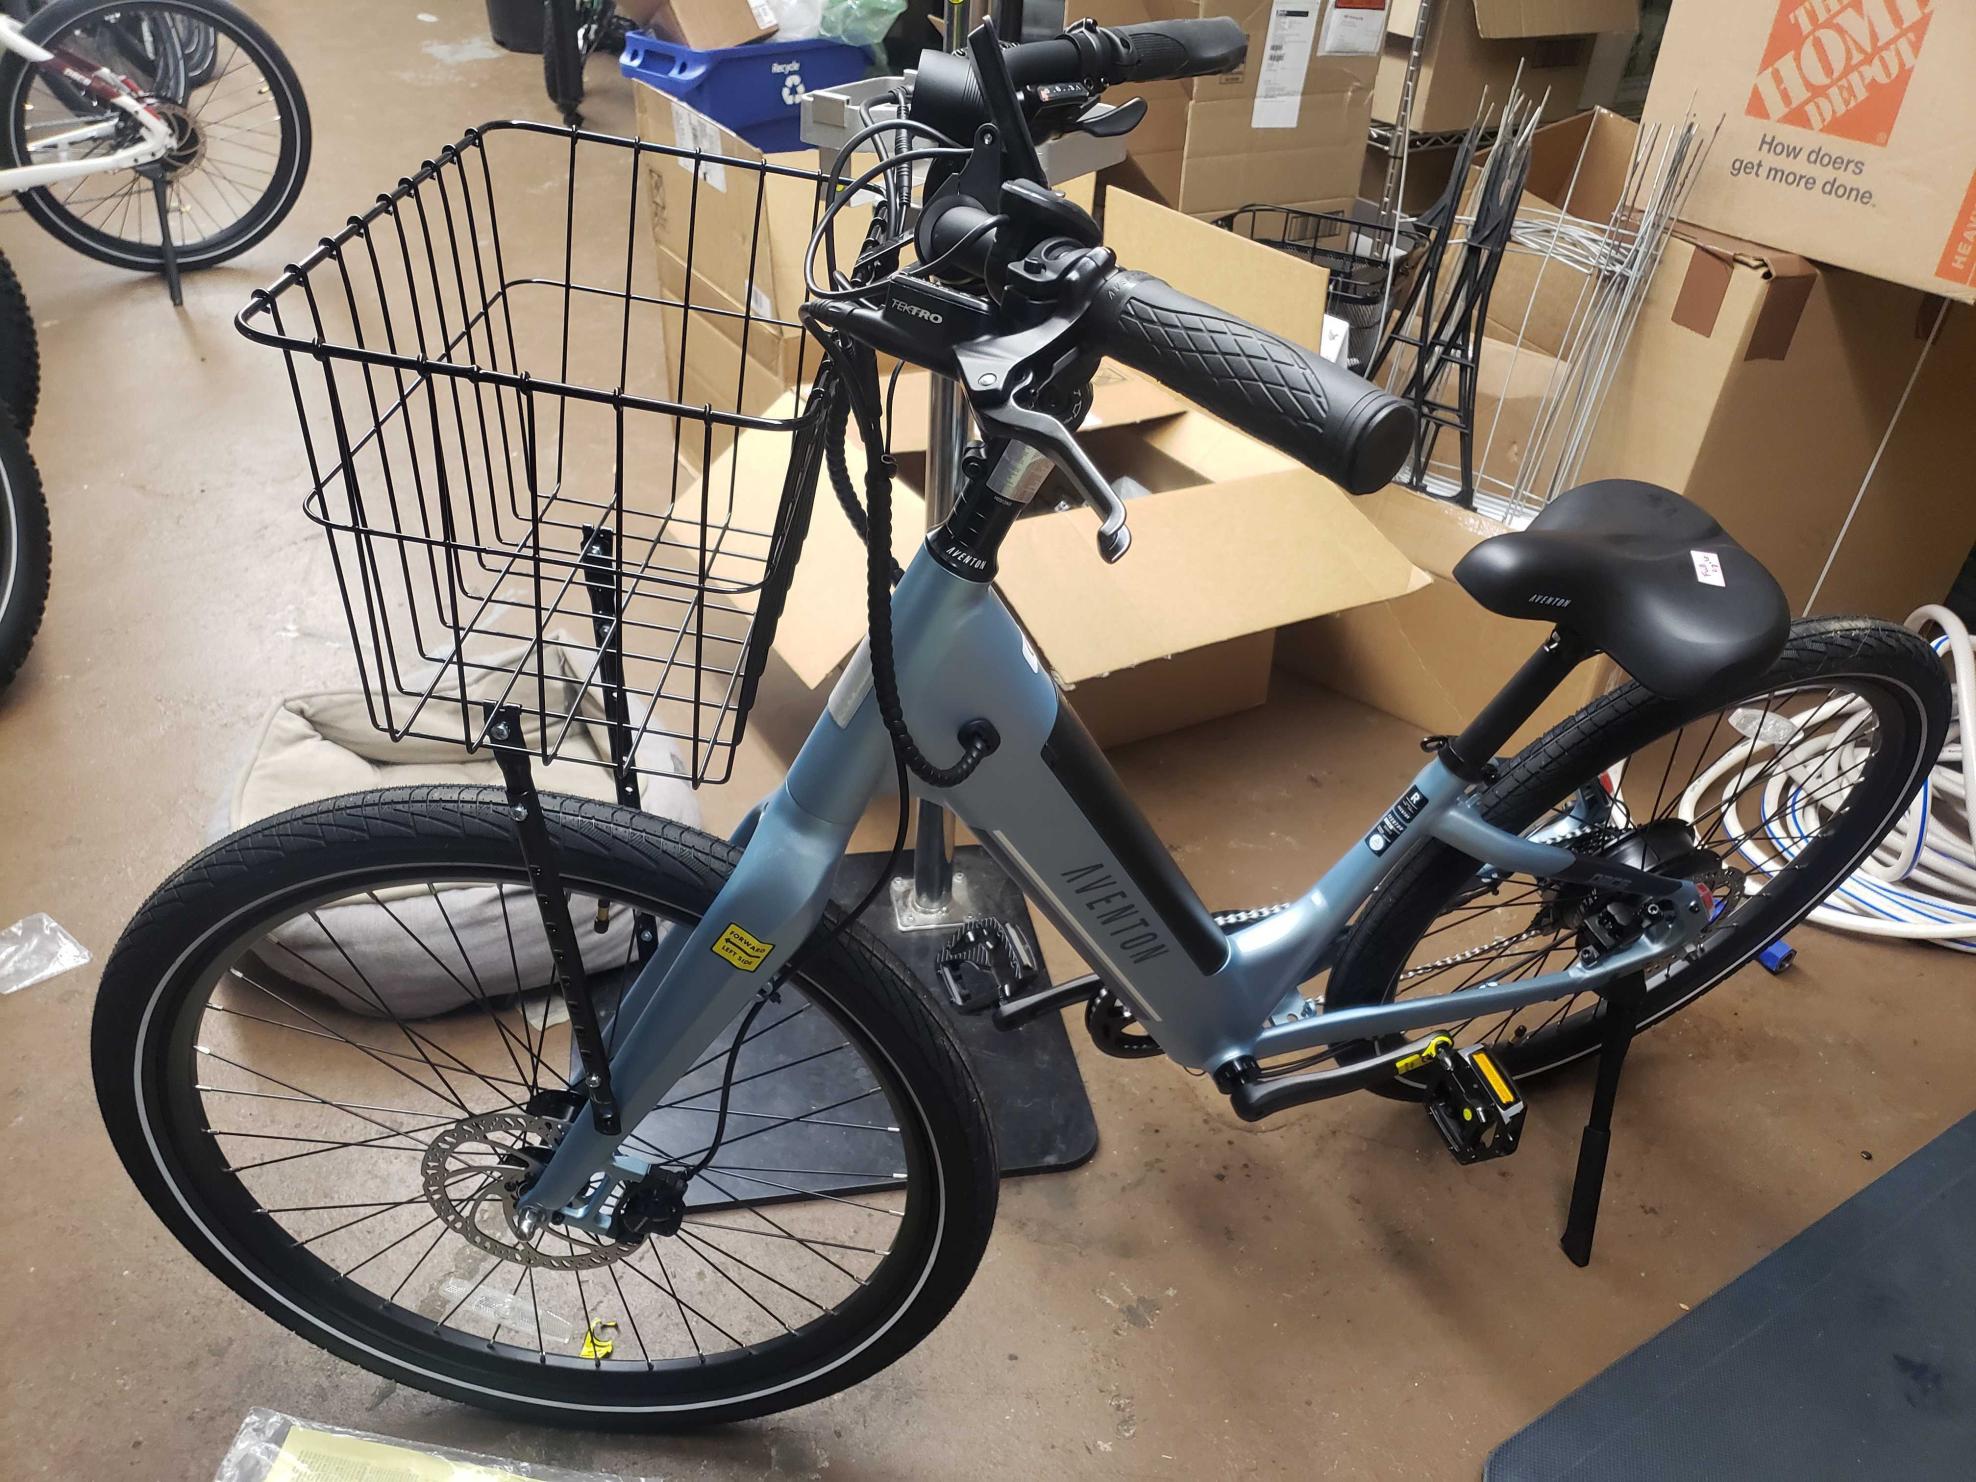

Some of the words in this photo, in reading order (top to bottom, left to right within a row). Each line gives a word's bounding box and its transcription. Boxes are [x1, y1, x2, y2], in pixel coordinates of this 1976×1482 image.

[1804, 31, 1916, 131] DEPOT
[1758, 133, 1802, 160] How
[1807, 146, 1865, 176] doers
[1730, 158, 1763, 178] get
[1766, 166, 1816, 191] more
[892, 299, 943, 324] TEKTRO
[946, 546, 987, 570] AVENTON
[1529, 594, 1572, 608] AVENTON
[1411, 792, 1420, 804] R
[1061, 863, 1169, 964] AVENTON
[730, 930, 766, 953] FORWARD
[722, 945, 737, 957] LEFT
[737, 956, 753, 966] SIDE
